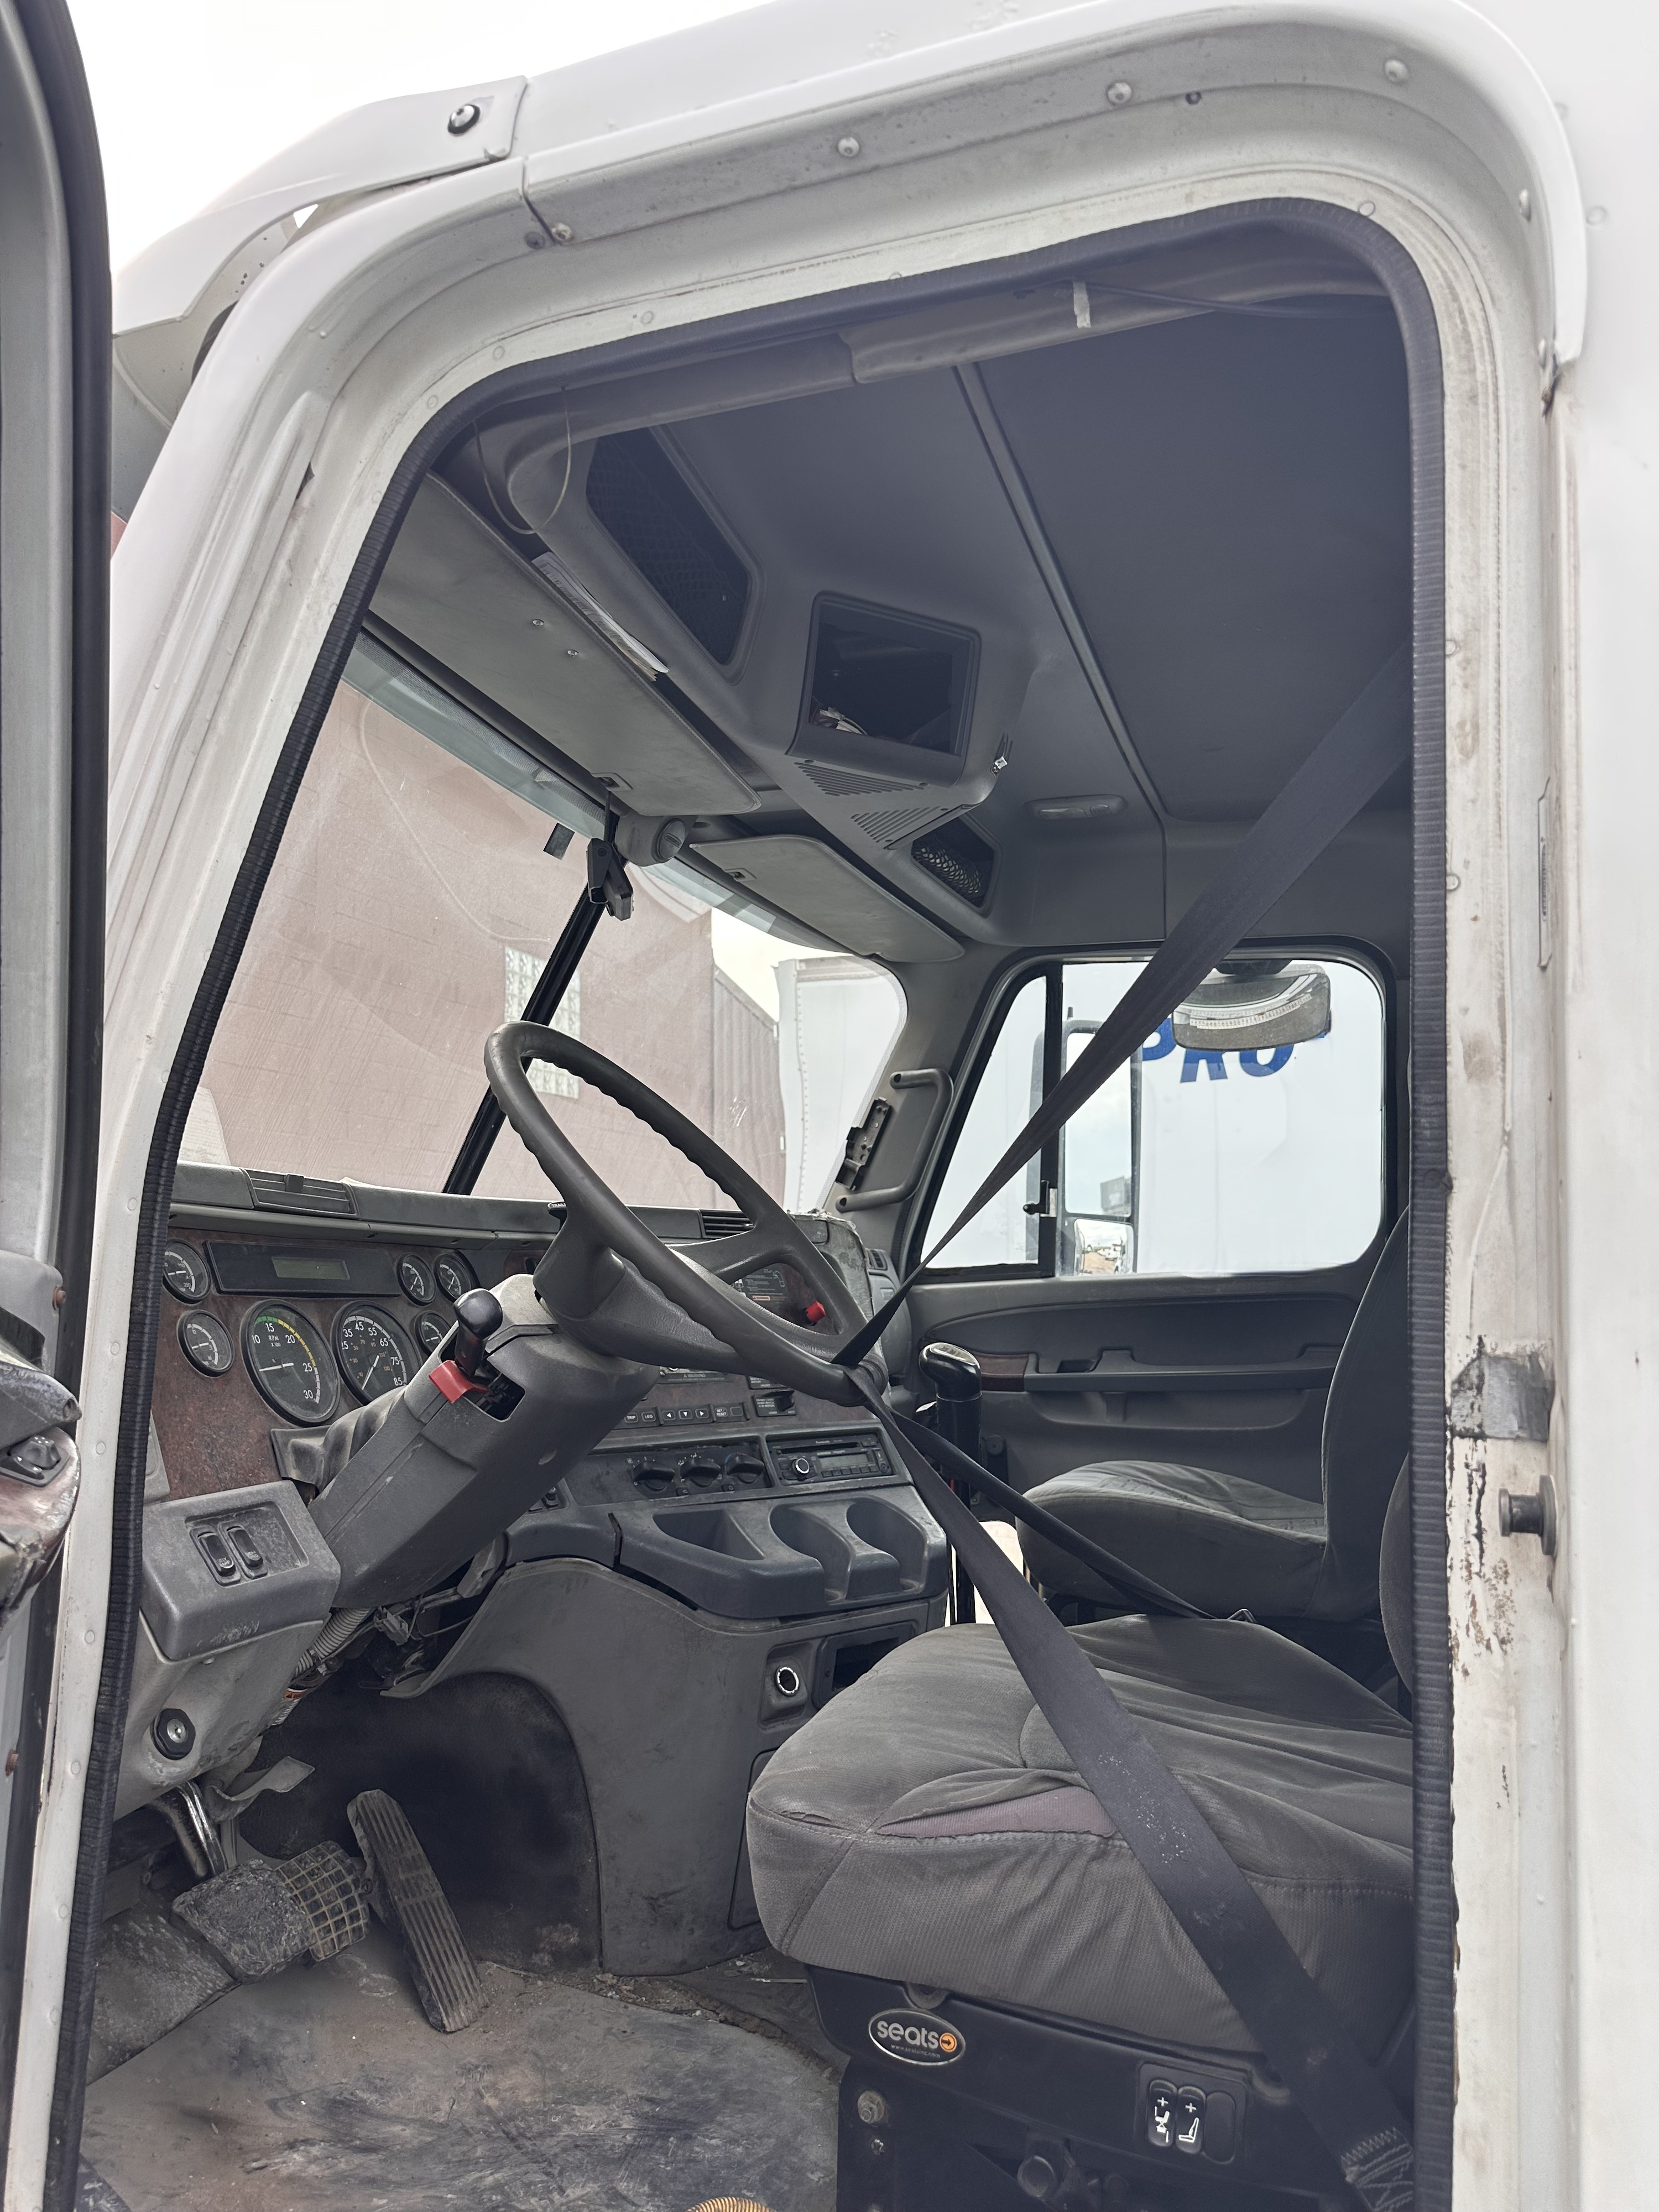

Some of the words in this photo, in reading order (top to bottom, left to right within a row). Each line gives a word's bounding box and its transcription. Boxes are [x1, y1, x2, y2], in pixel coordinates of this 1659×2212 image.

[265, 1323, 274, 1332] 15
[355, 1322, 364, 1331] 45
[343, 1328, 353, 1337] 35
[368, 1327, 377, 1336] 55
[252, 1334, 260, 1344] 10
[285, 1334, 295, 1344] 20
[380, 1338, 389, 1347] 65
[390, 1357, 400, 1365] 75
[302, 1363, 312, 1372] 25
[393, 1377, 403, 1386] 85
[304, 1390, 313, 1399] 30
[877, 2020, 939, 2049] seats
